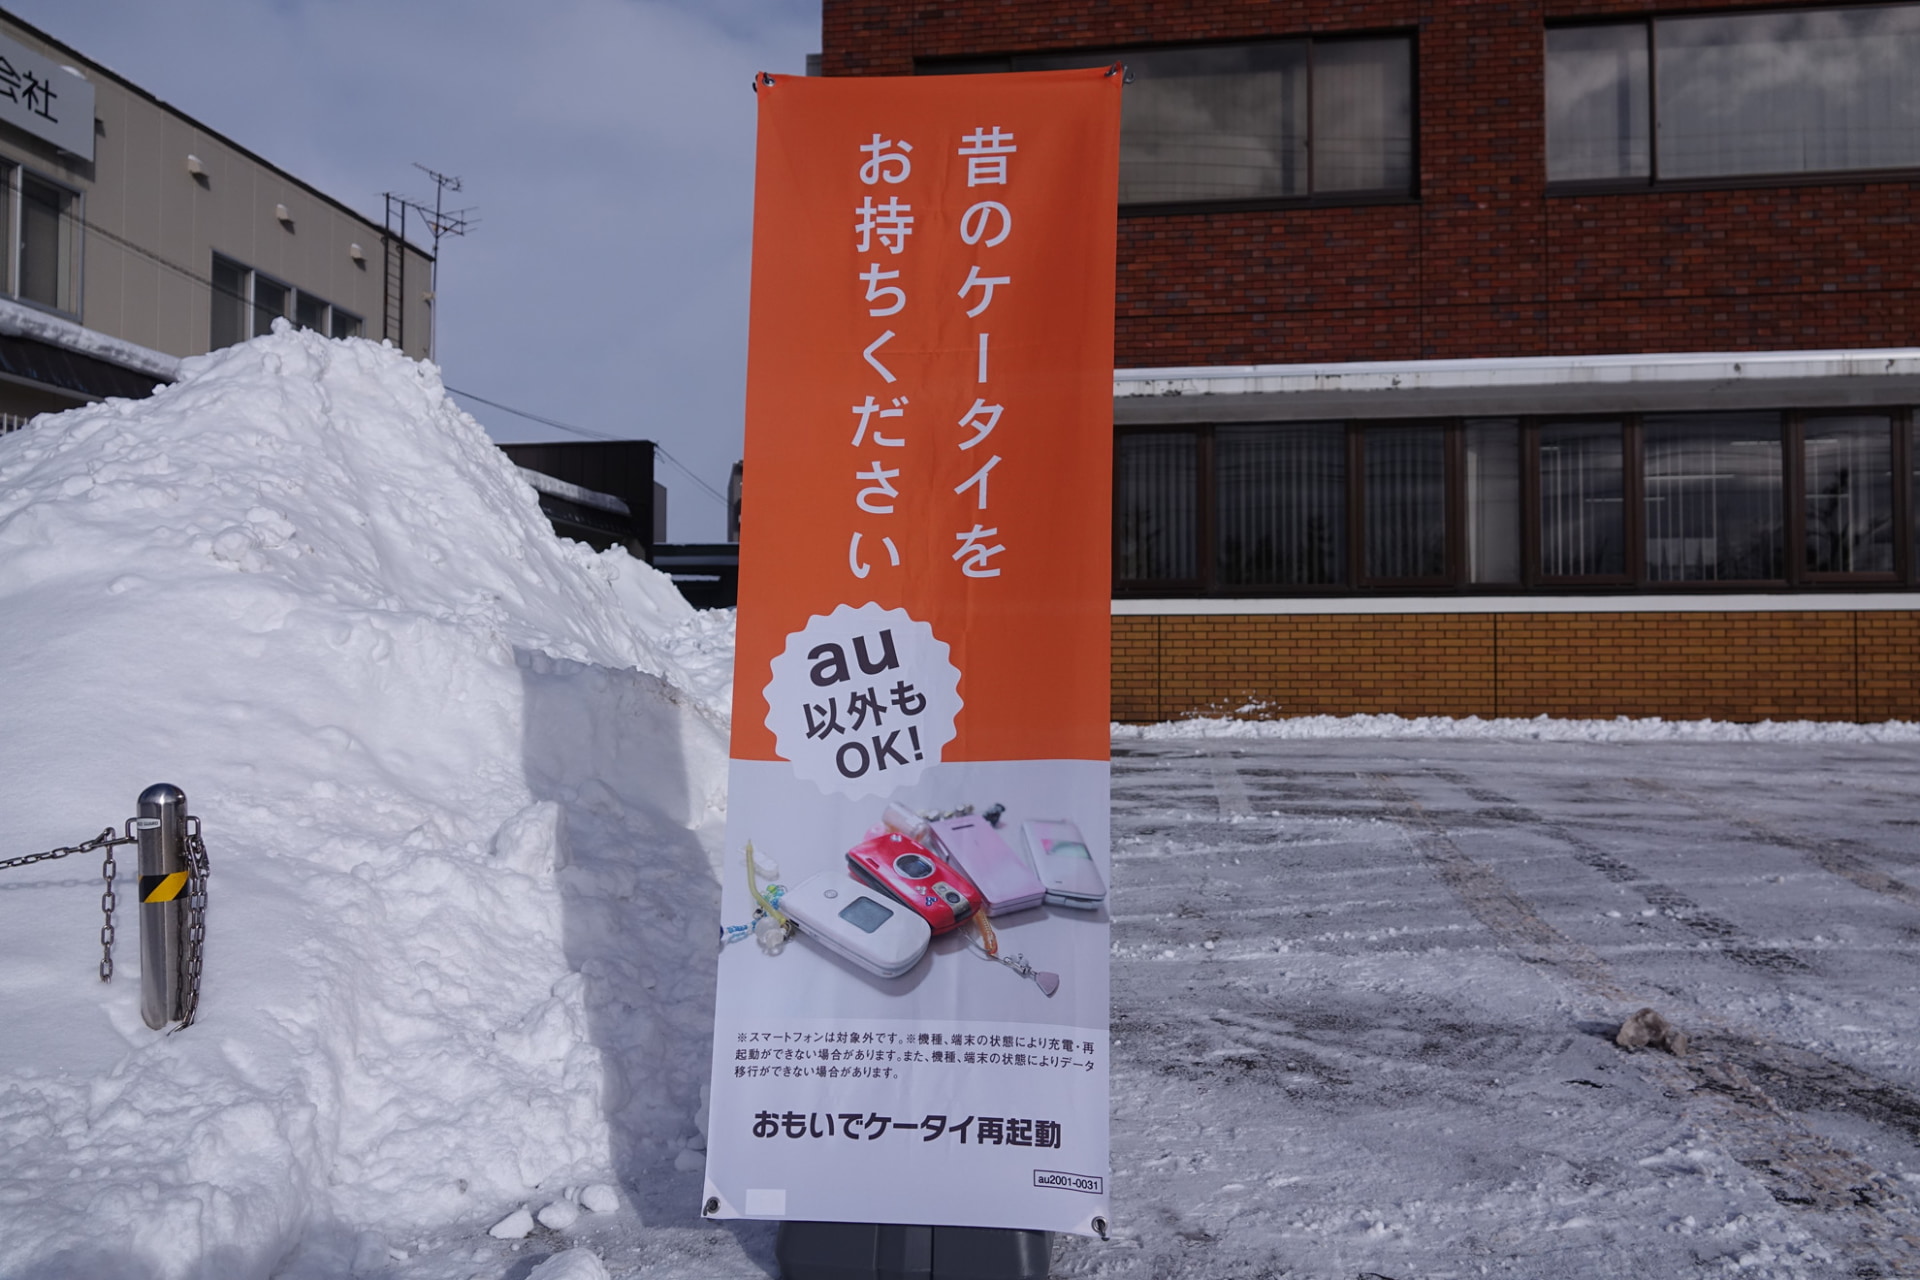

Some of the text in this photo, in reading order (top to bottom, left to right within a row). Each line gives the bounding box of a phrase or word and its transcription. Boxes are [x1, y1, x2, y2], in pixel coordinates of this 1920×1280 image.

[849, 133, 914, 579] お持ちください
[953, 126, 1017, 577] 昔のケータイを
[807, 629, 900, 687] au
[803, 681, 927, 740] 以外も
[836, 726, 924, 778] OK!
[734, 1066, 898, 1079] 移行ができない場合があります。
[752, 1111, 1062, 1149] おもいでケータイ再起動
[1038, 1175, 1098, 1190] au2001-0031
